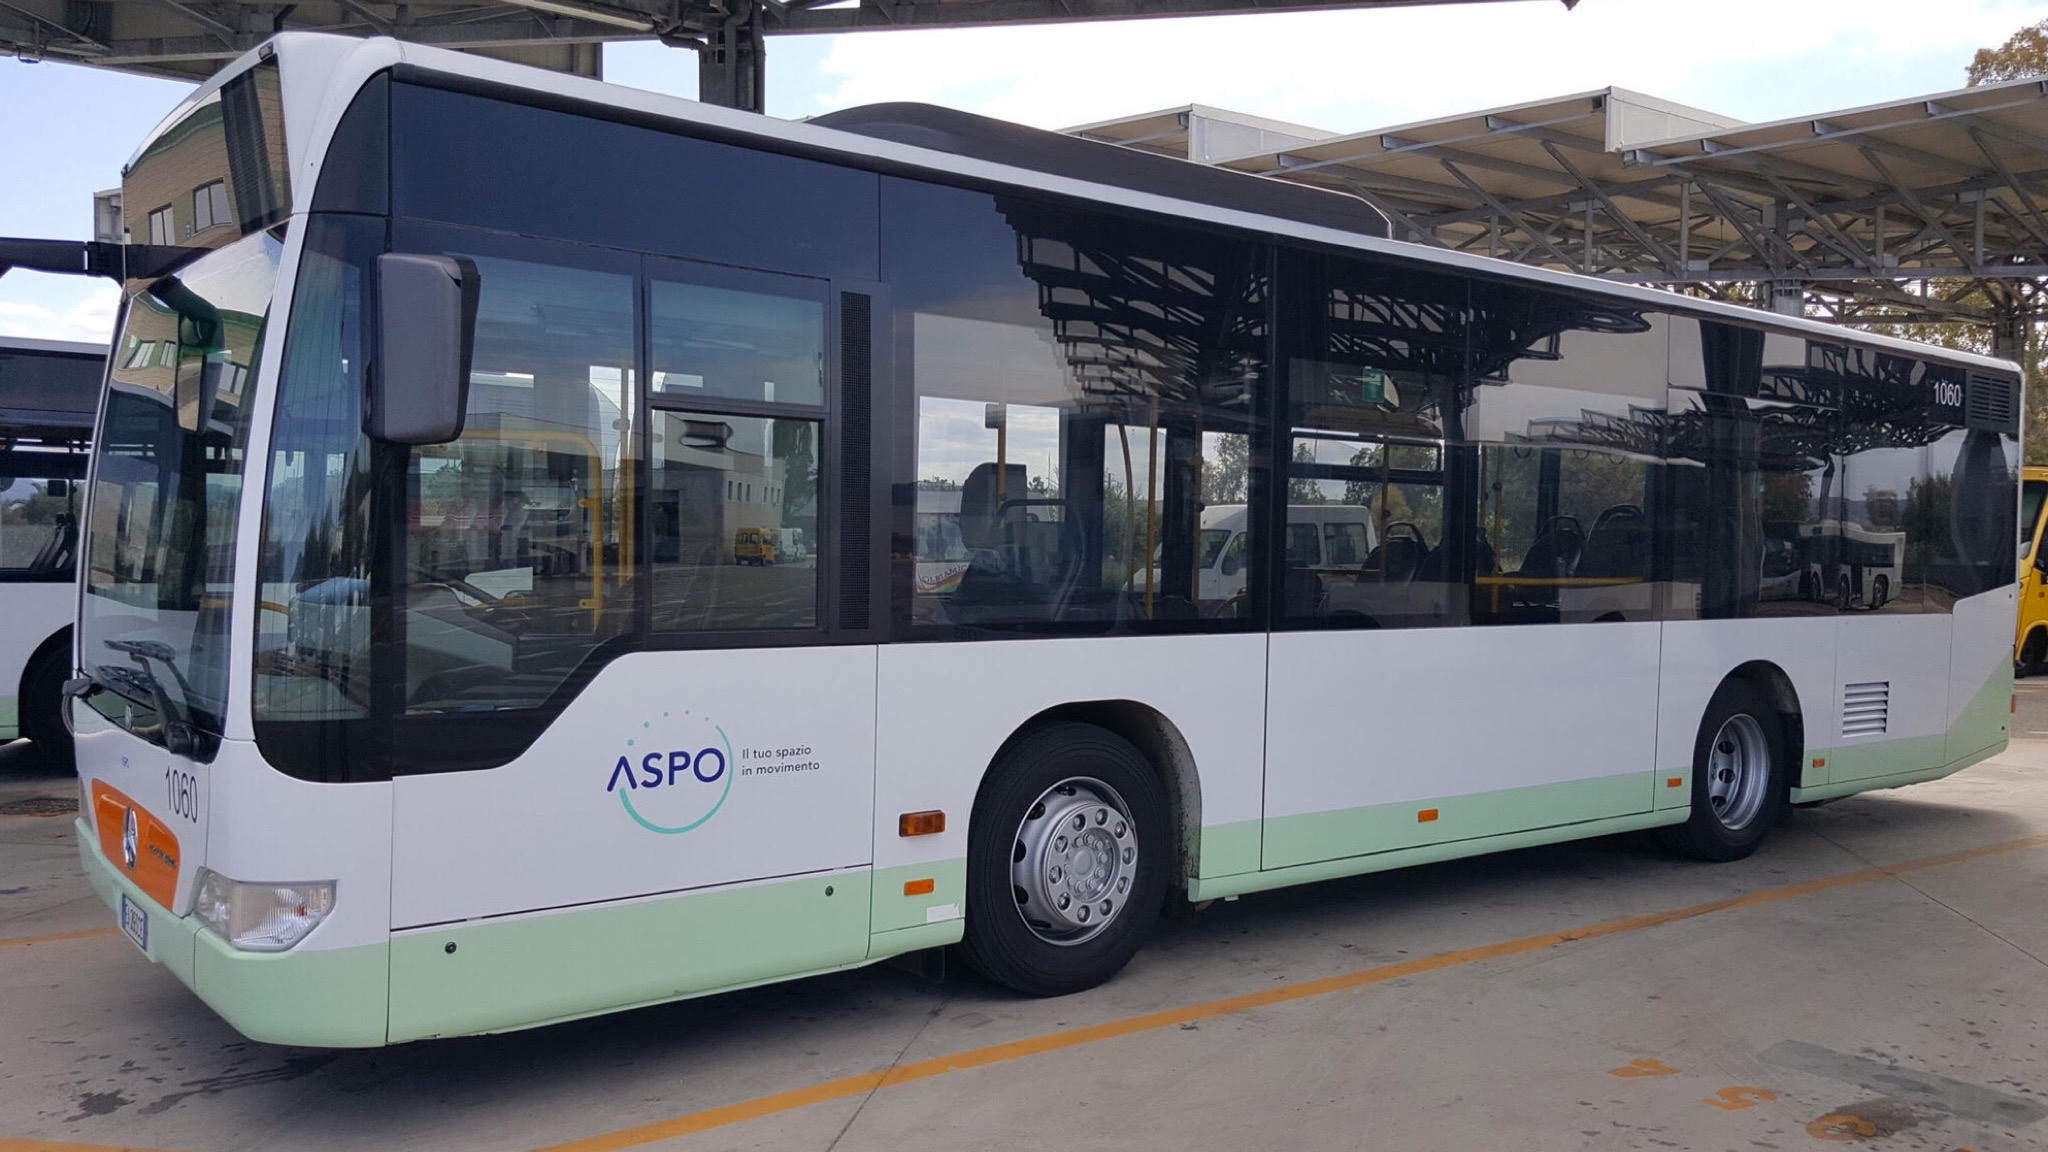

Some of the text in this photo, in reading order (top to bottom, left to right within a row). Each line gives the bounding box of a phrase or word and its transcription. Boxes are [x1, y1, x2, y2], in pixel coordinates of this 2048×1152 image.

[1933, 381, 1961, 407] 1060
[741, 744, 812, 760] Il tuo spazio
[606, 747, 726, 792] ASPO
[741, 760, 821, 776] in movimento
[165, 766, 198, 824] 1060
